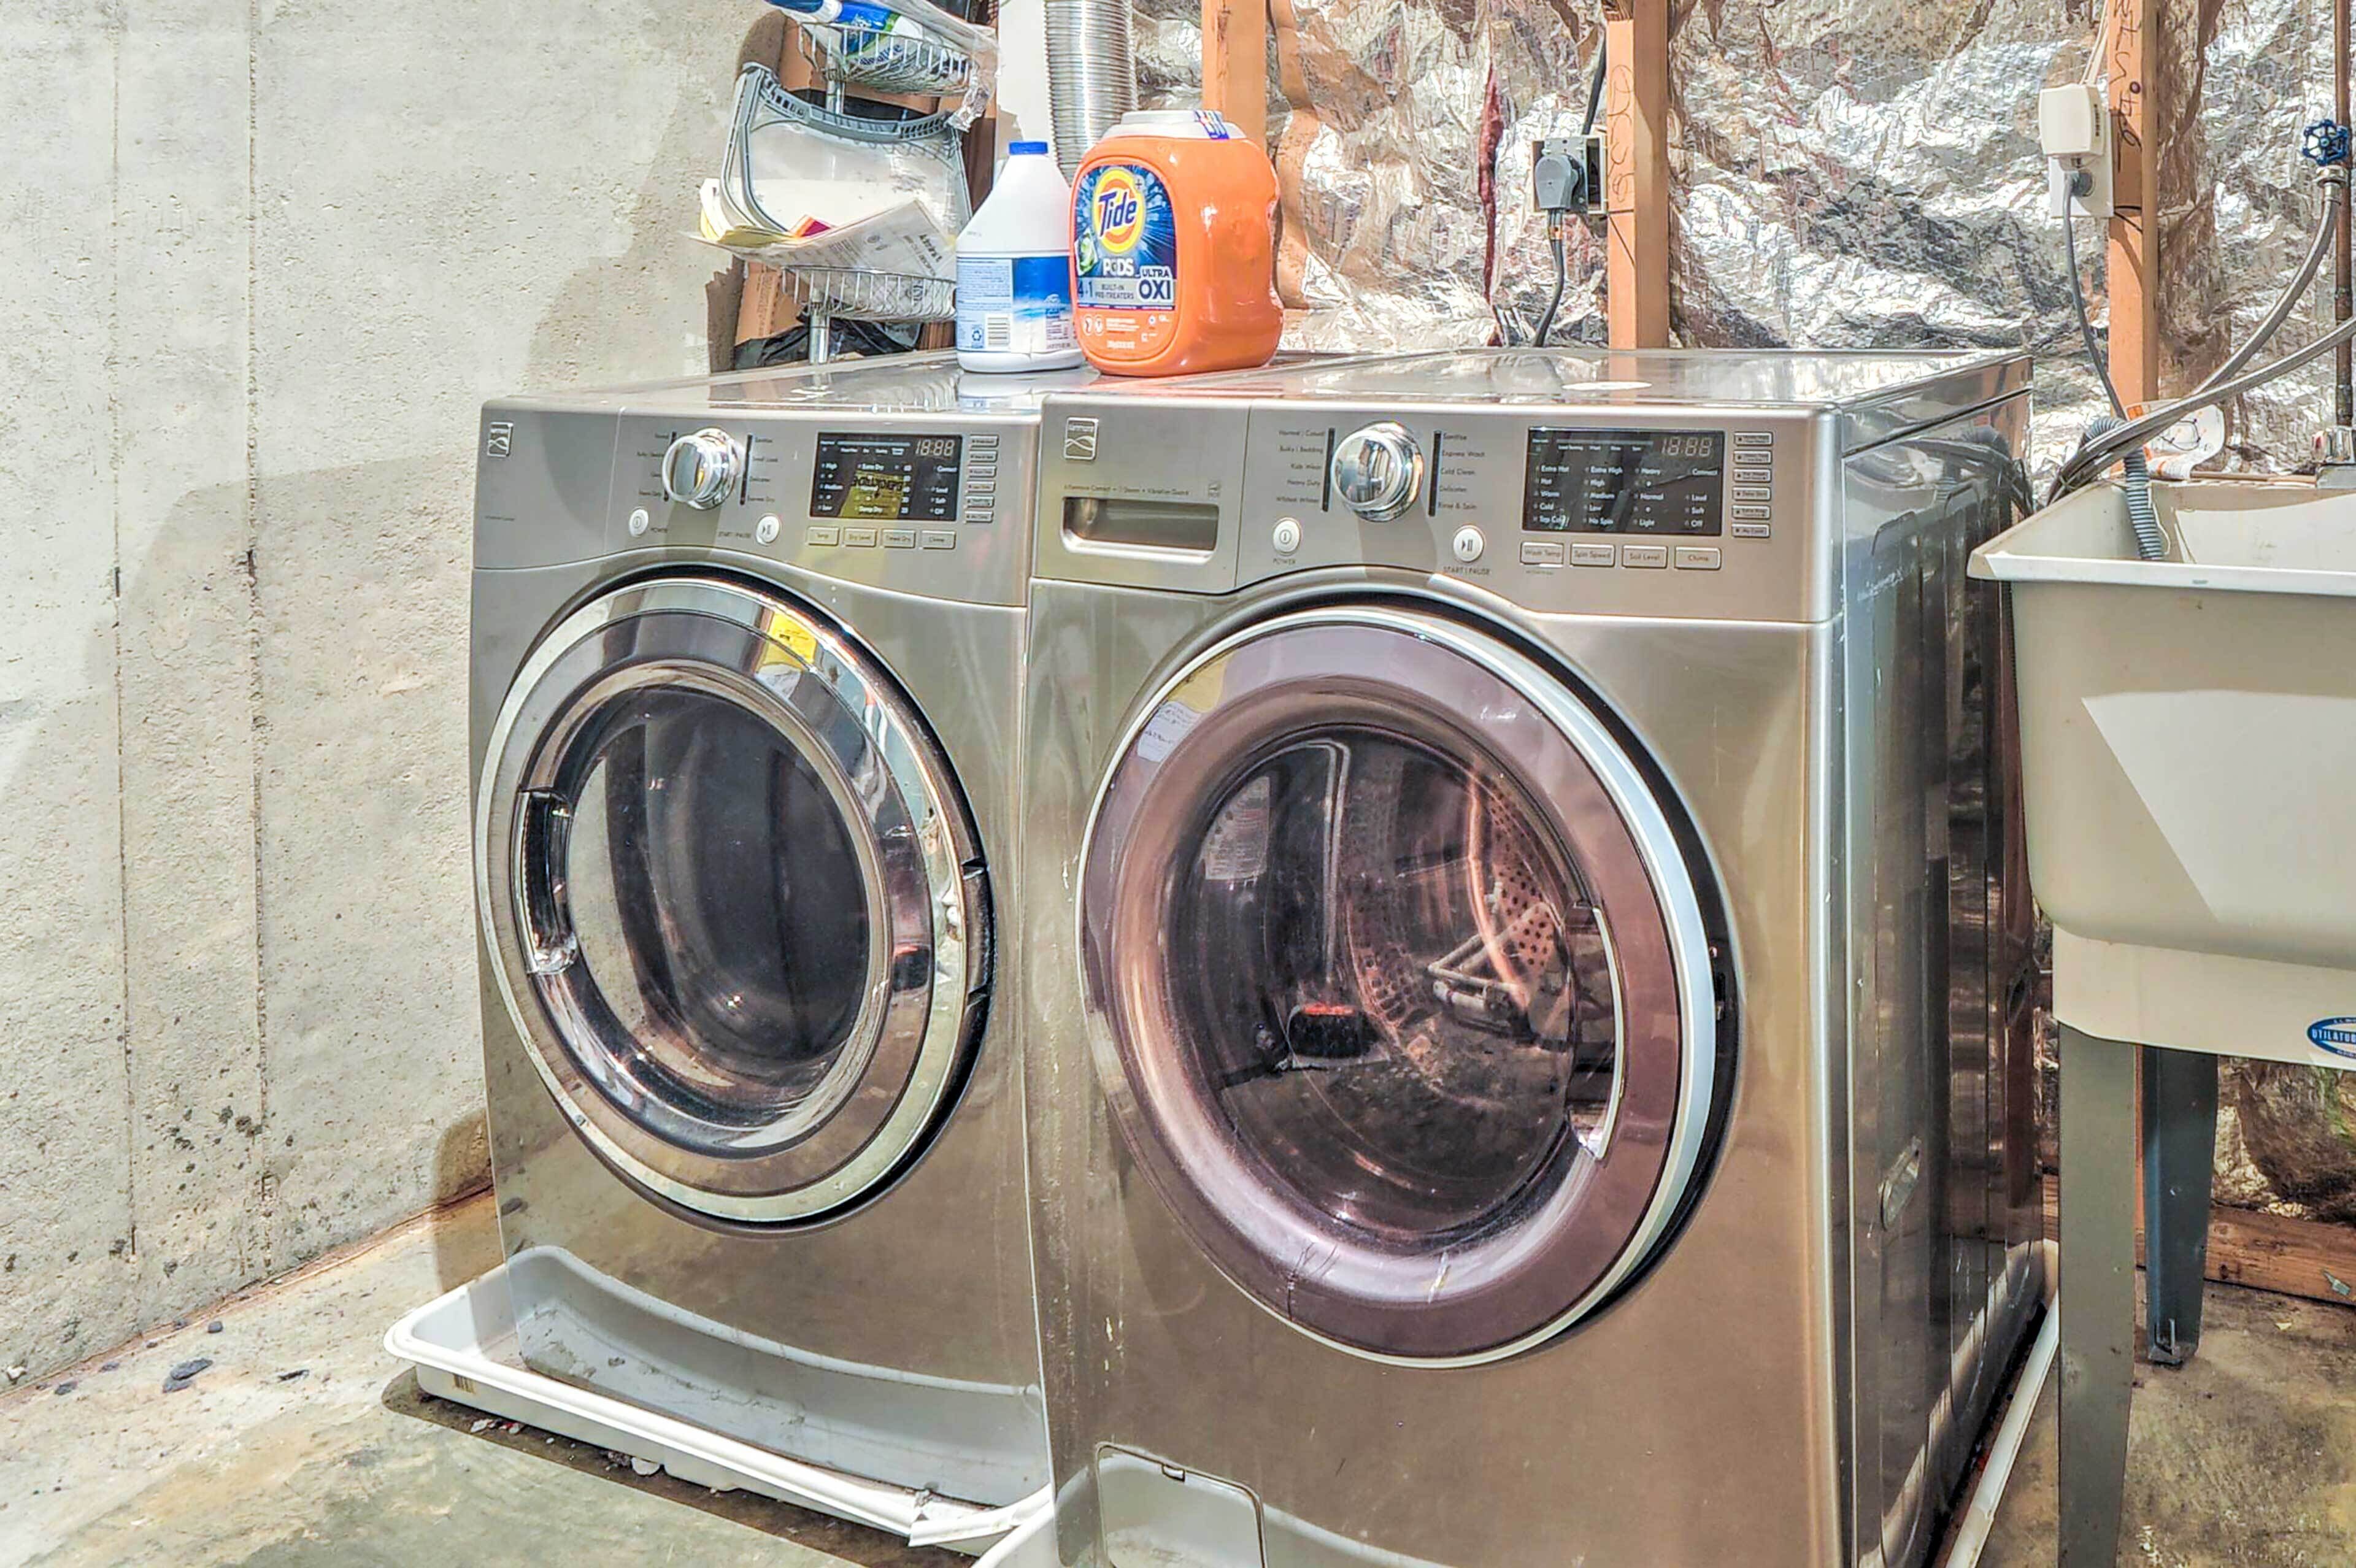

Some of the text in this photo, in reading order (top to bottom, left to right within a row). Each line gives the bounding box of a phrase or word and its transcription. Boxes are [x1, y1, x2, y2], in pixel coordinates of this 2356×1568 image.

[1098, 191, 1137, 237] Tide
[1102, 258, 1134, 276] PODS
[1142, 269, 1169, 277] ULTRA
[1139, 280, 1171, 299] OXI
[1608, 466, 1623, 475] High
[1590, 478, 1605, 487] High
[1639, 518, 1655, 528] Light
